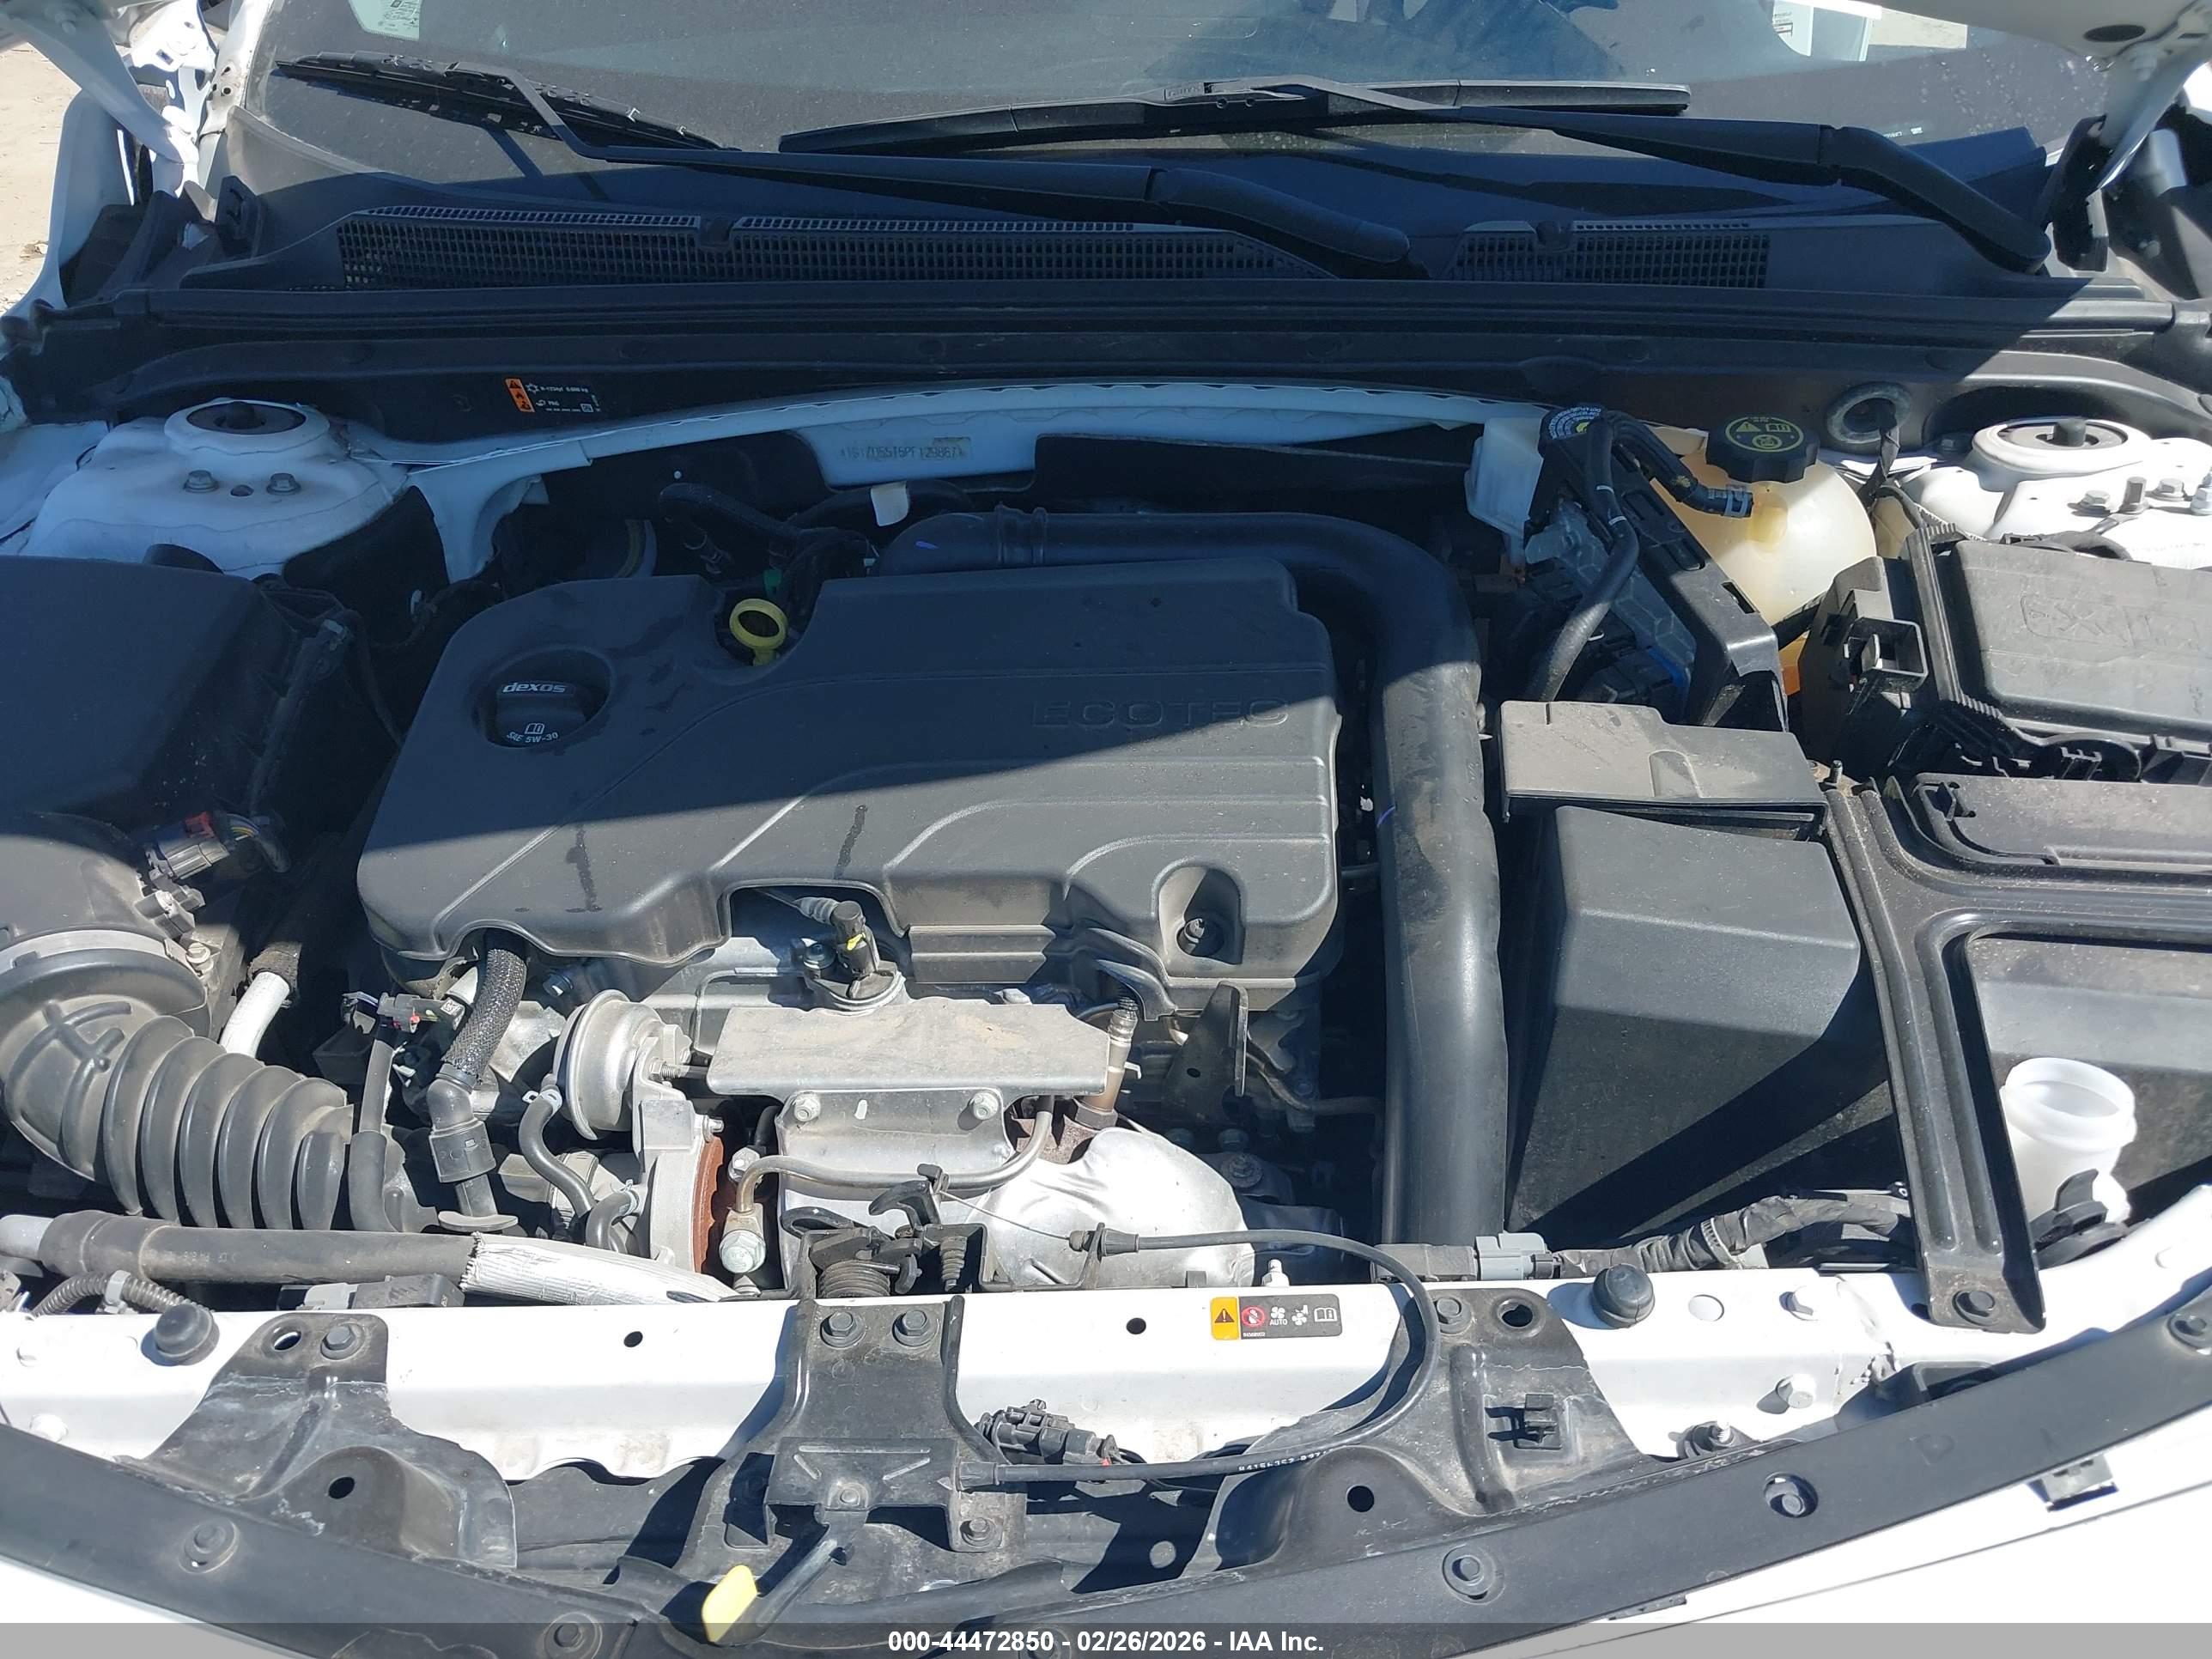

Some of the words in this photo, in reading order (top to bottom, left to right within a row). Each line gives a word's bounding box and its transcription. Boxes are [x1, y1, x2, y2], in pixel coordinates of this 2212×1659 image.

[502, 682, 566, 693] dexos
[1031, 697, 1289, 728] ECOTEC
[507, 732, 524, 742] SAE
[525, 732, 559, 743] 5W-30
